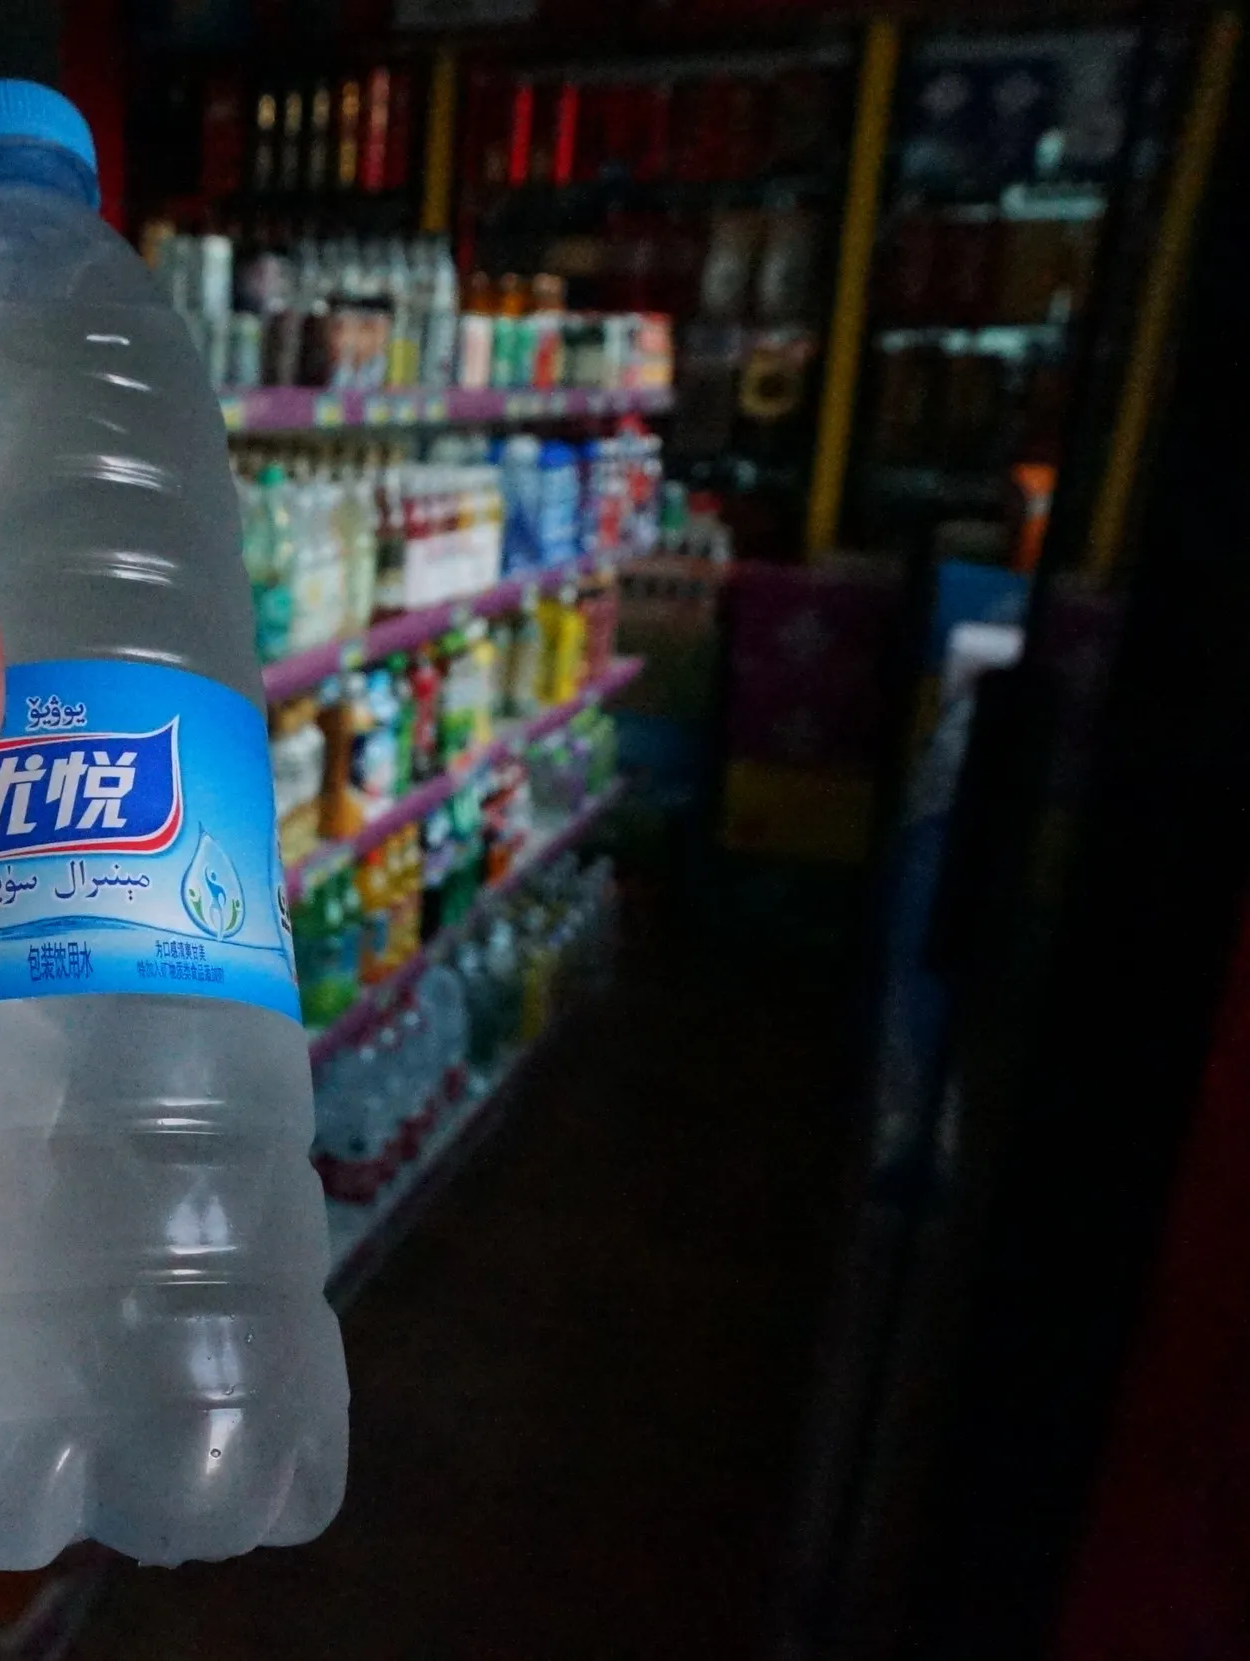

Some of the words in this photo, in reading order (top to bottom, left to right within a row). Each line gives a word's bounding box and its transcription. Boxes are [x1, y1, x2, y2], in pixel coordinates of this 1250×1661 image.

[28, 941, 94, 981] 包装饮用水
